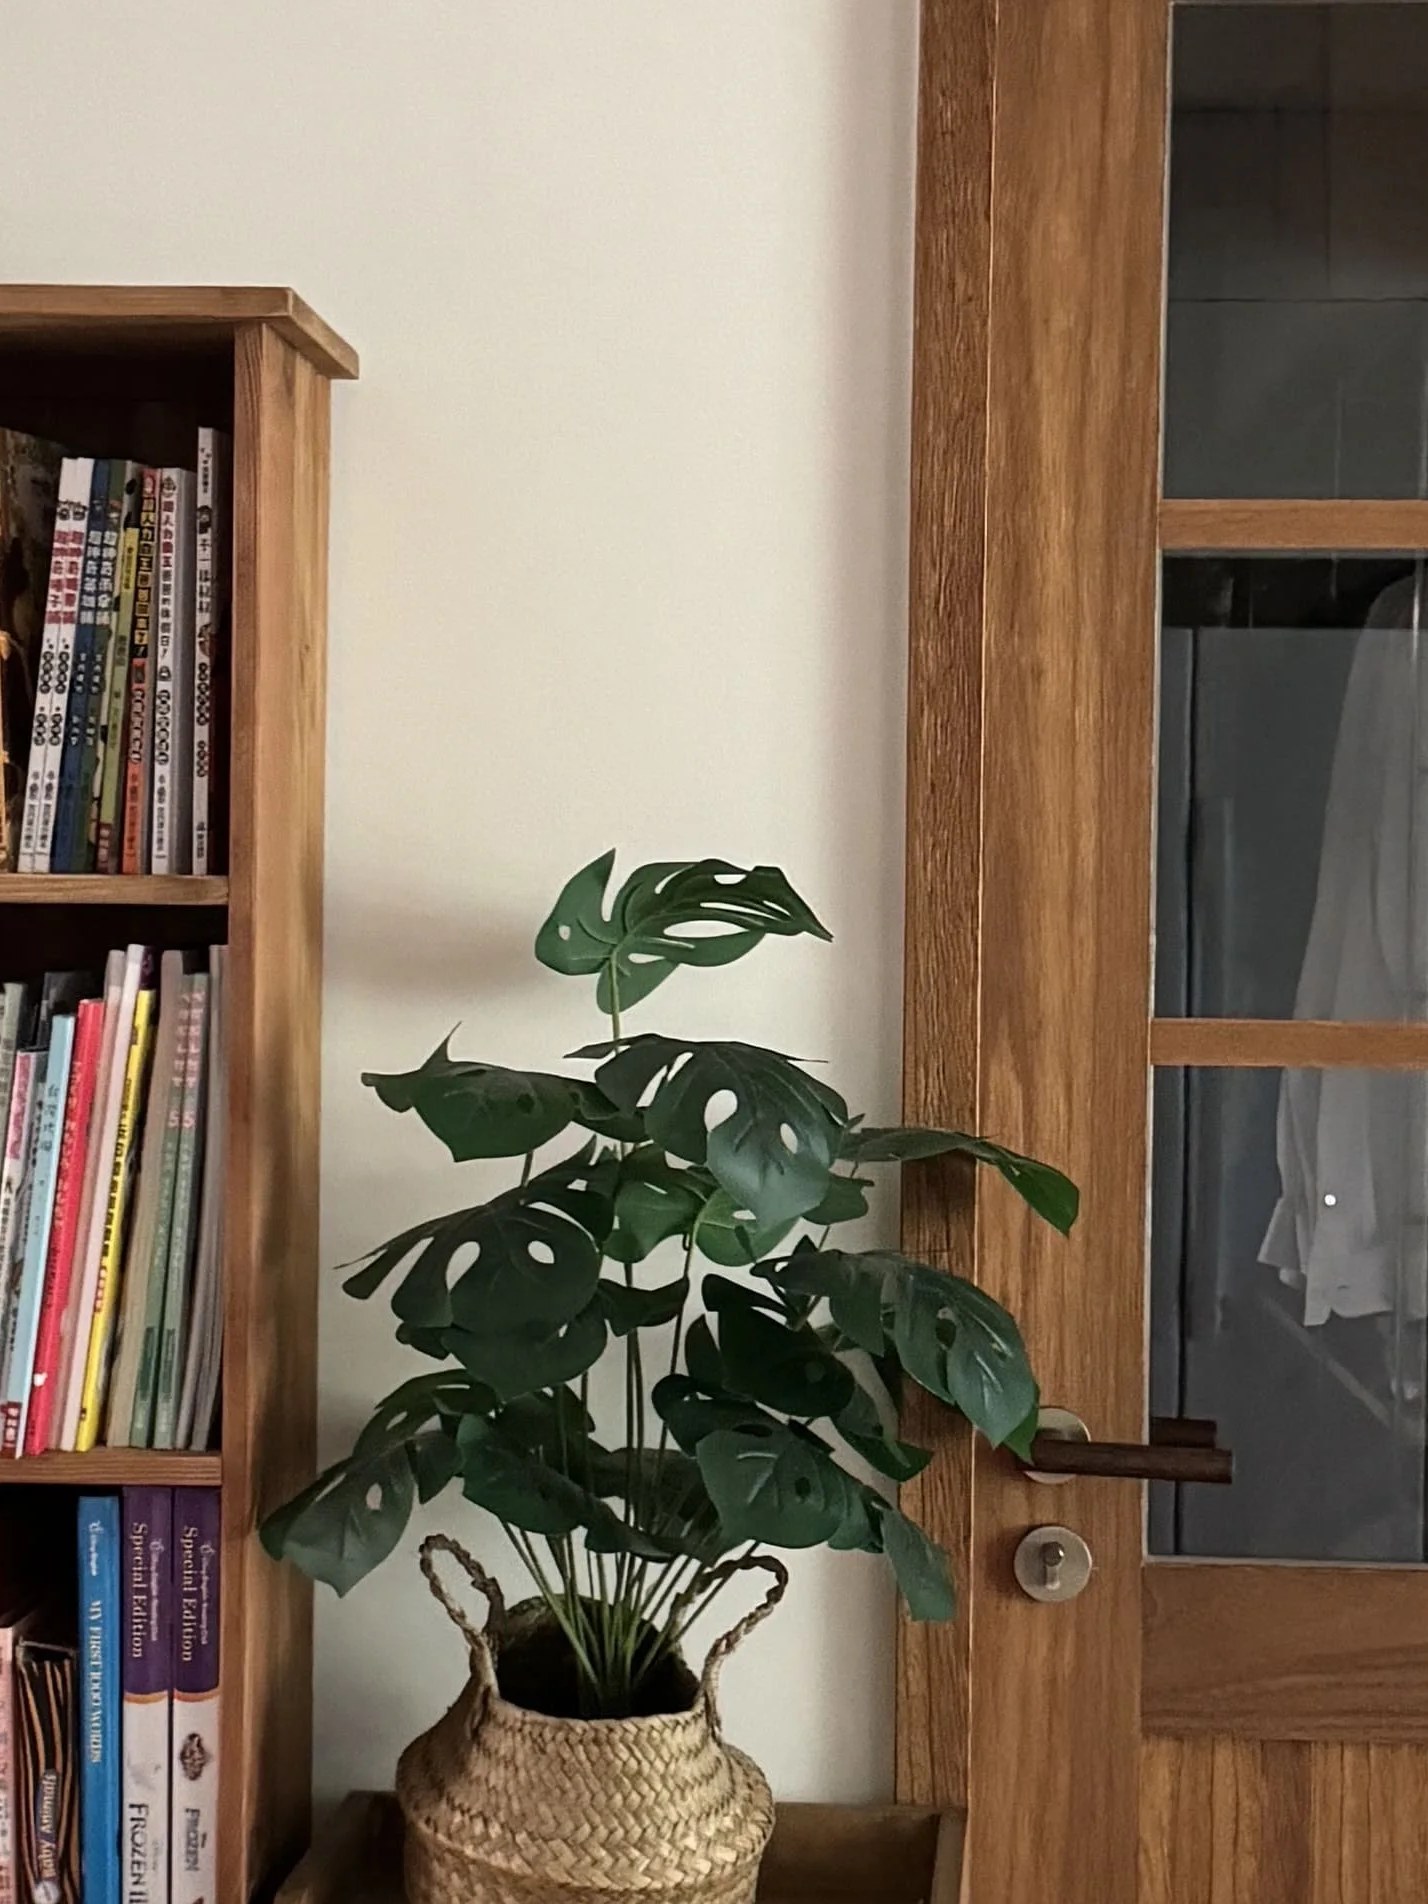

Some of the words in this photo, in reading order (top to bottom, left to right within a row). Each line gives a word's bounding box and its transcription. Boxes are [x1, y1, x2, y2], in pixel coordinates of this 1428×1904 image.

[129, 1522, 147, 1591] Special
[180, 1526, 198, 1592] Special
[88, 1599, 102, 1621] MY
[130, 1595, 148, 1658] Edition
[181, 1598, 198, 1662] Edition
[89, 1626, 102, 1669] FIRST
[38, 1839, 57, 1879] Baby
[128, 1802, 149, 1885] FROZEN
[183, 1807, 201, 1872] FROZEN
